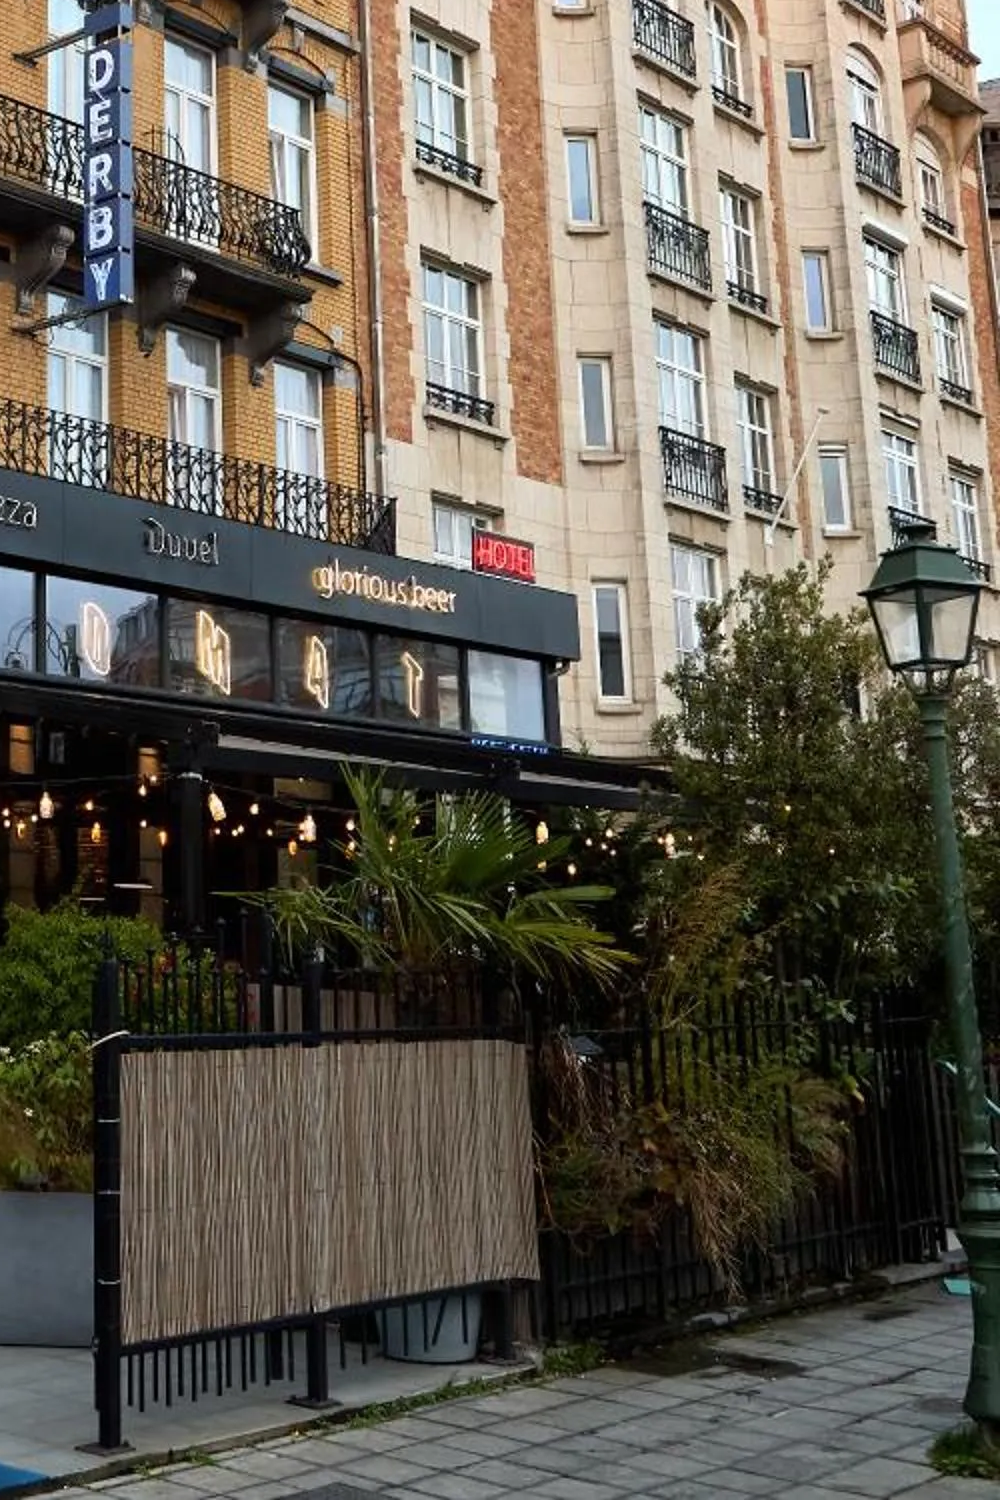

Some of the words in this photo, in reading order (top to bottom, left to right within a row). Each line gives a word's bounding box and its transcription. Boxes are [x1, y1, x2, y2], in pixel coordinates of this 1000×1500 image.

[87, 49, 115, 301] DERBY
[141, 516, 220, 566] Duvel
[475, 536, 536, 578] HOTEL
[312, 557, 408, 605] glorious
[410, 575, 457, 614] beer
